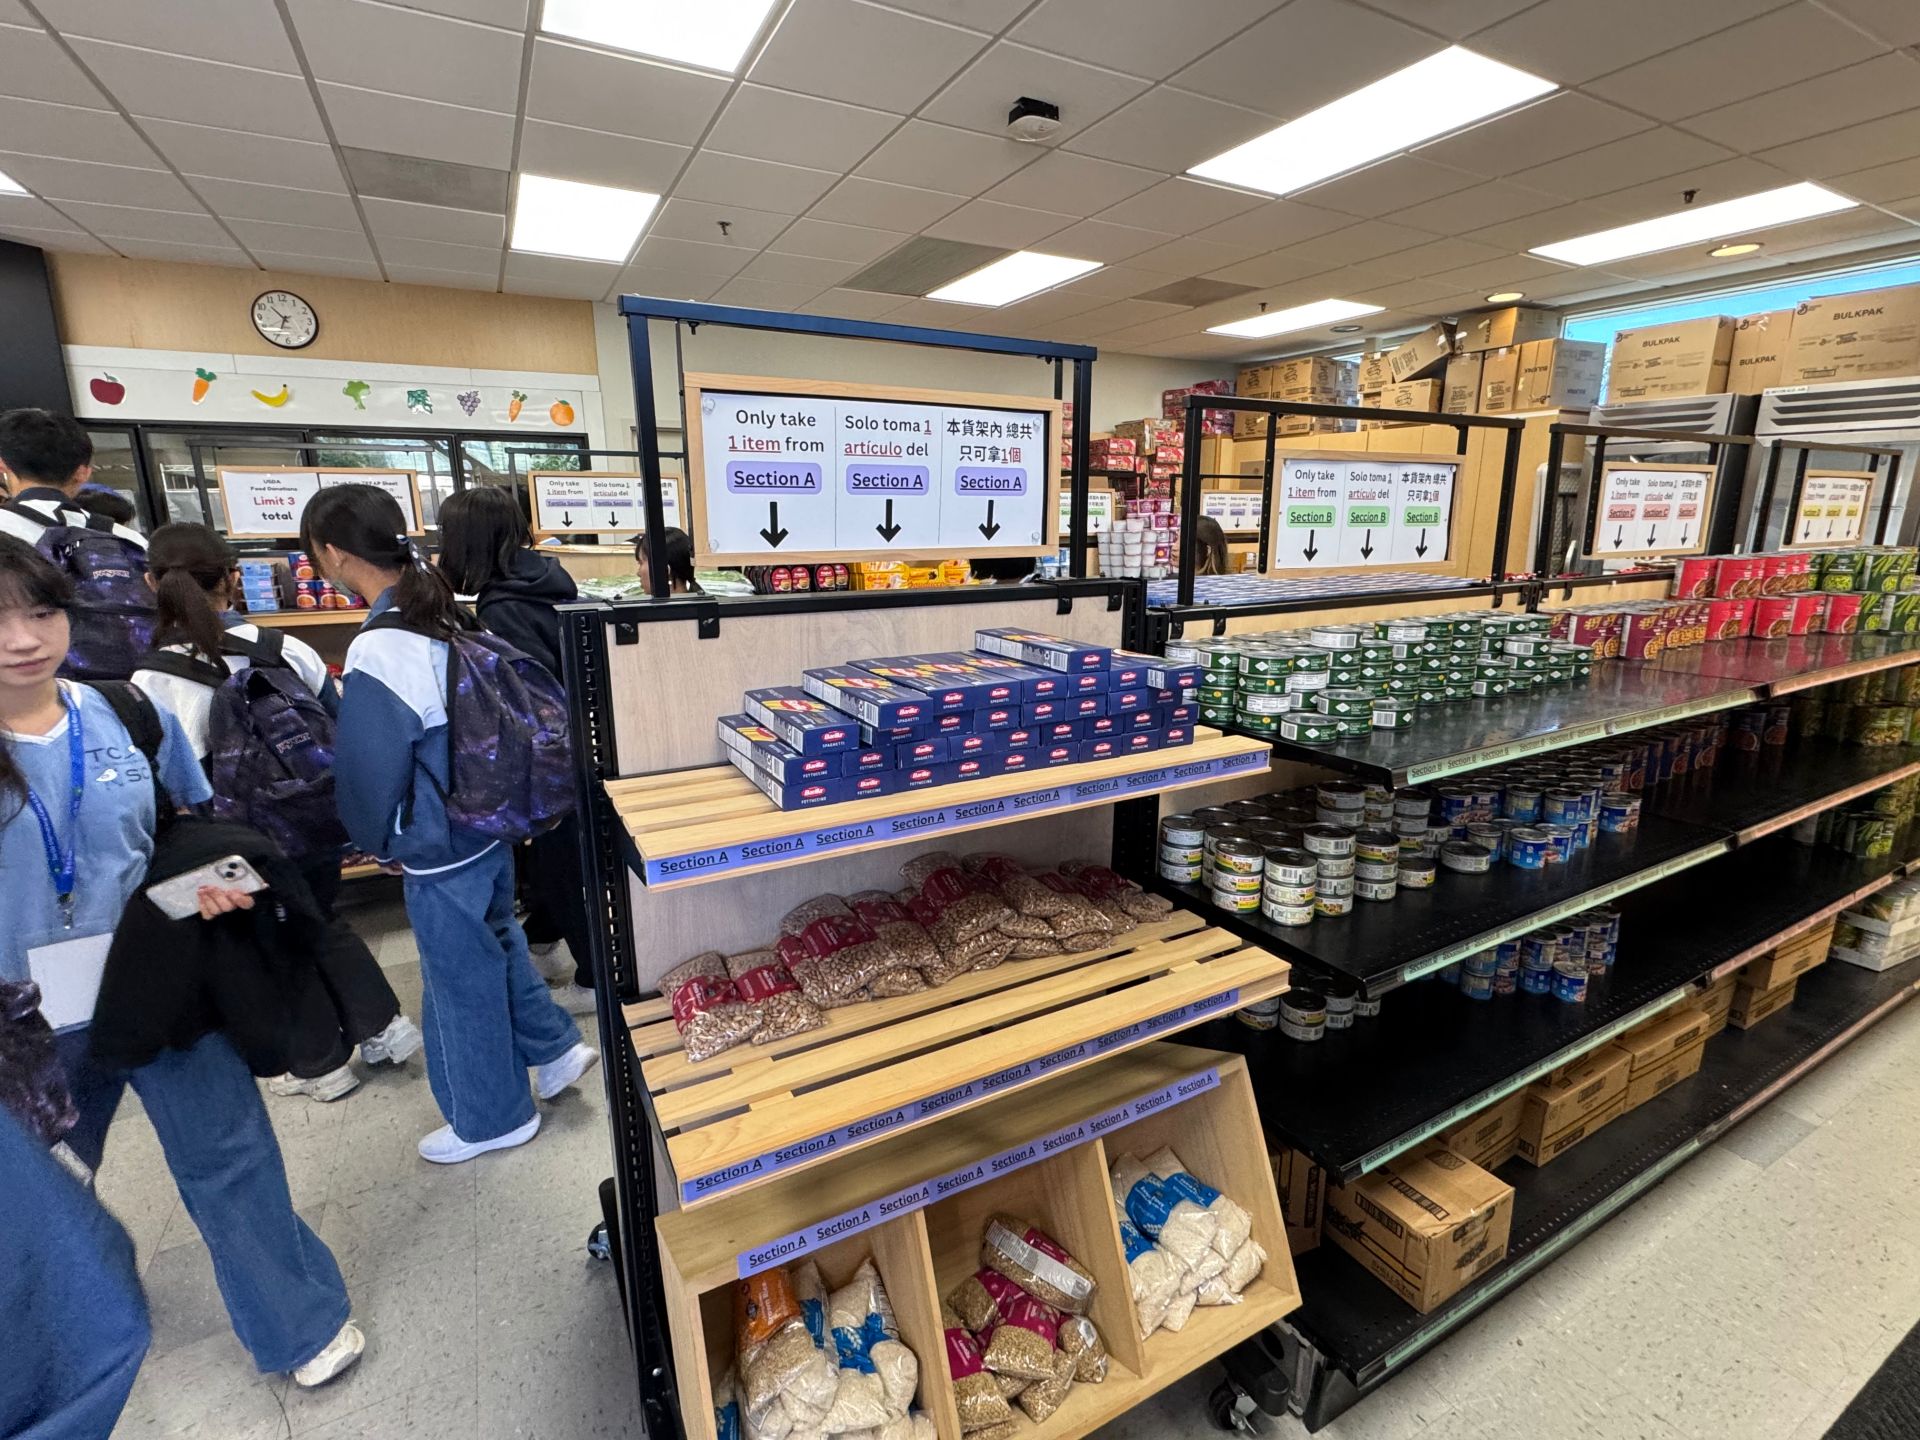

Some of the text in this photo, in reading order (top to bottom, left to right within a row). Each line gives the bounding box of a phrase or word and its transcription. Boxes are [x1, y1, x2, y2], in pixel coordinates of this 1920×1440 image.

[266, 296, 274, 304] 11
[277, 294, 287, 302] 12
[257, 303, 266, 311] 10
[302, 307, 308, 315] 2
[1833, 307, 1884, 321] BULKPAK
[307, 318, 312, 326] 3
[1642, 336, 1680, 348] BULKPAK
[1739, 354, 1777, 367] BULKPAK
[736, 410, 816, 428] Only take
[846, 416, 932, 432] Solo toma 1
[728, 436, 824, 452] 1 item from
[844, 440, 928, 456] artículo del
[734, 470, 816, 486] Section A
[852, 473, 924, 488] Section A
[1295, 470, 1335, 482] Only take
[1350, 472, 1392, 482] Solo toma 1
[549, 480, 564, 488] Only
[960, 475, 1022, 488] Section A
[1616, 478, 1628, 487] Only
[1288, 487, 1336, 498] 1 item from
[1378, 489, 1390, 498] del
[254, 496, 296, 506] Limit 3
[262, 512, 293, 521] total
[1290, 512, 1332, 522] Section B
[1381, 512, 1386, 522] B
[1406, 512, 1438, 522] Section B
[1609, 508, 1635, 518] Section C
[1644, 508, 1662, 518] Section
[899, 706, 918, 715] Barilla
[897, 716, 920, 724] SPAGHETTI
[823, 731, 844, 740] Barilla
[803, 788, 824, 796] Barilla
[660, 854, 714, 872] Section
[718, 850, 728, 863] A
[742, 840, 792, 858] Section
[794, 838, 804, 848] A
[816, 828, 862, 844] Section
[864, 825, 874, 836] A
[892, 816, 935, 832] Section
[936, 812, 946, 822] A
[955, 804, 995, 820] Section
[997, 800, 1004, 811] A
[1014, 792, 1050, 808] Section
[1052, 790, 1060, 800] A
[1076, 782, 1112, 796] Section
[1112, 779, 1119, 789] A
[1126, 773, 1158, 786] Section
[1160, 770, 1166, 780] A
[1174, 765, 1204, 777] Section
[1205, 762, 1212, 772] A
[1222, 756, 1250, 768] Section
[1251, 754, 1257, 762] A
[696, 992, 1230, 1190] Section A Section A Section A Section A Section A Section A Section A Section A Section A
[749, 1074, 1213, 1266] Section A Section A Section A Section A Section A Section A Section A Section A Section A
